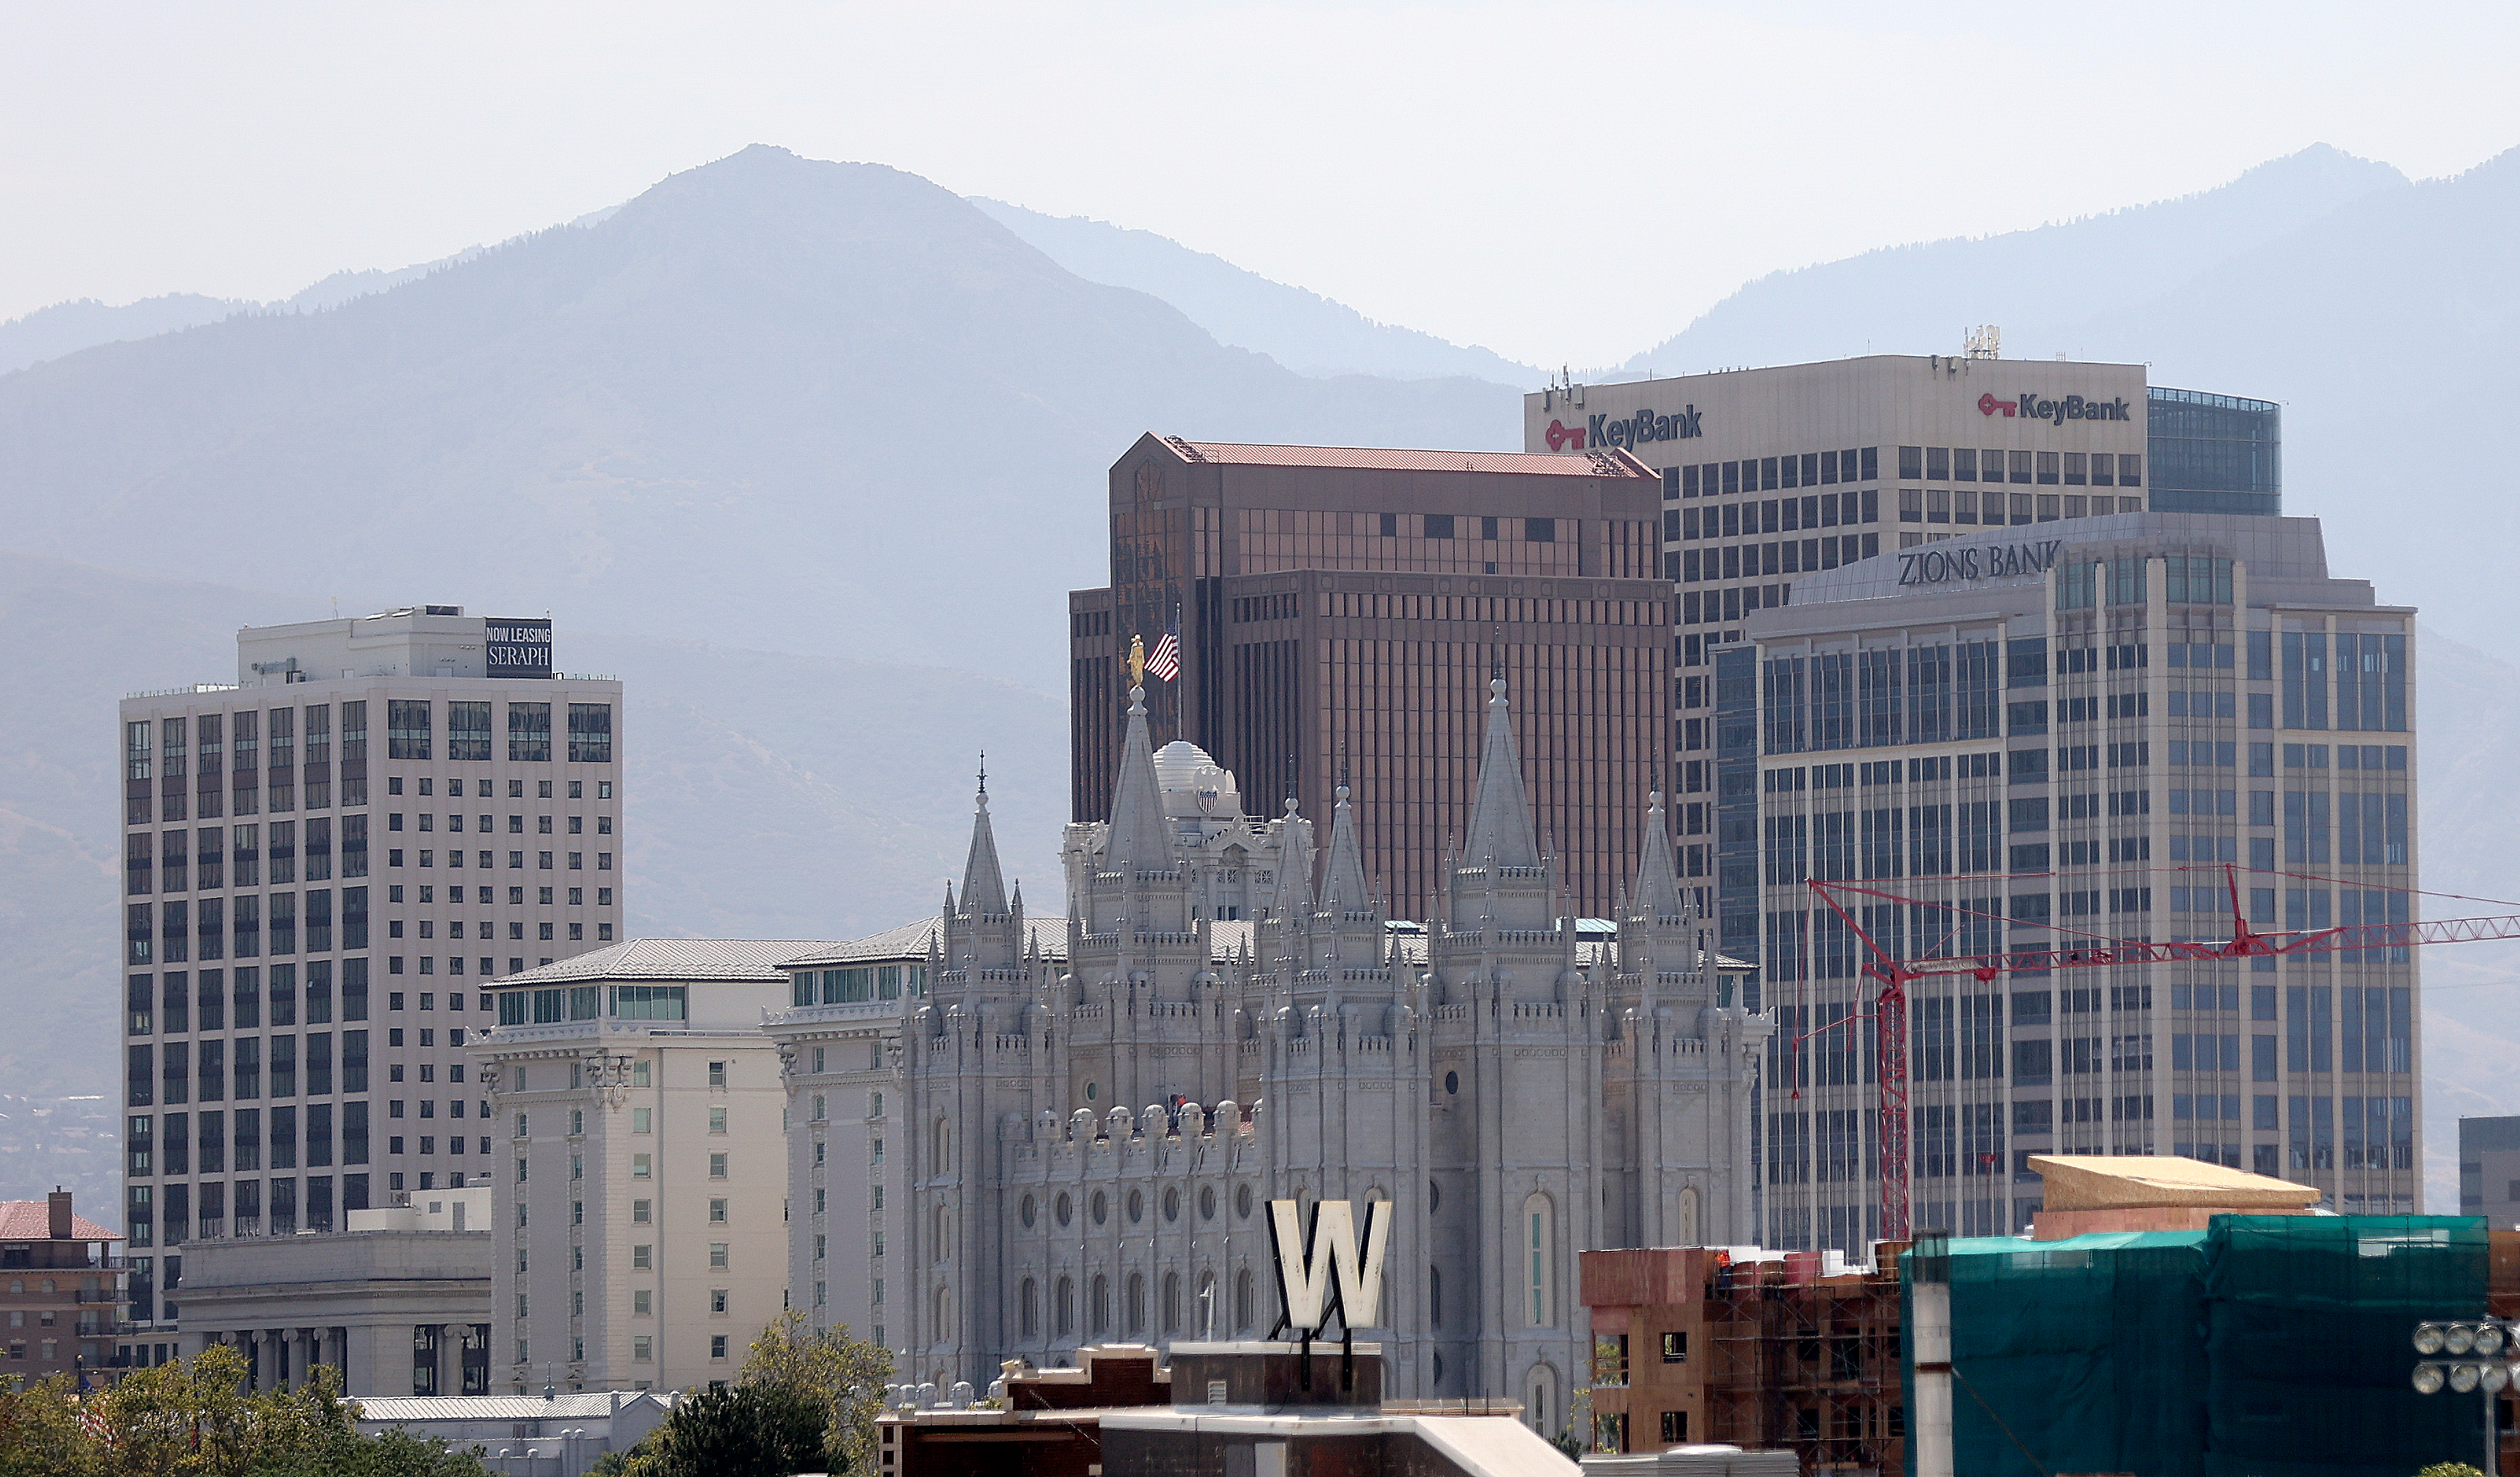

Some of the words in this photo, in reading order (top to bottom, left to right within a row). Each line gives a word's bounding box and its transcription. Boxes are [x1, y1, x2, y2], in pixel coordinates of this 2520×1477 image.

[2020, 393, 2130, 426] KeyBank
[1588, 404, 1703, 452] KeyBank
[1898, 547, 1979, 586] ZIONS
[486, 627, 509, 642] NOW
[511, 628, 551, 644] LEASING
[489, 645, 549, 665] SERAPH
[1264, 1201, 1393, 1329] W
